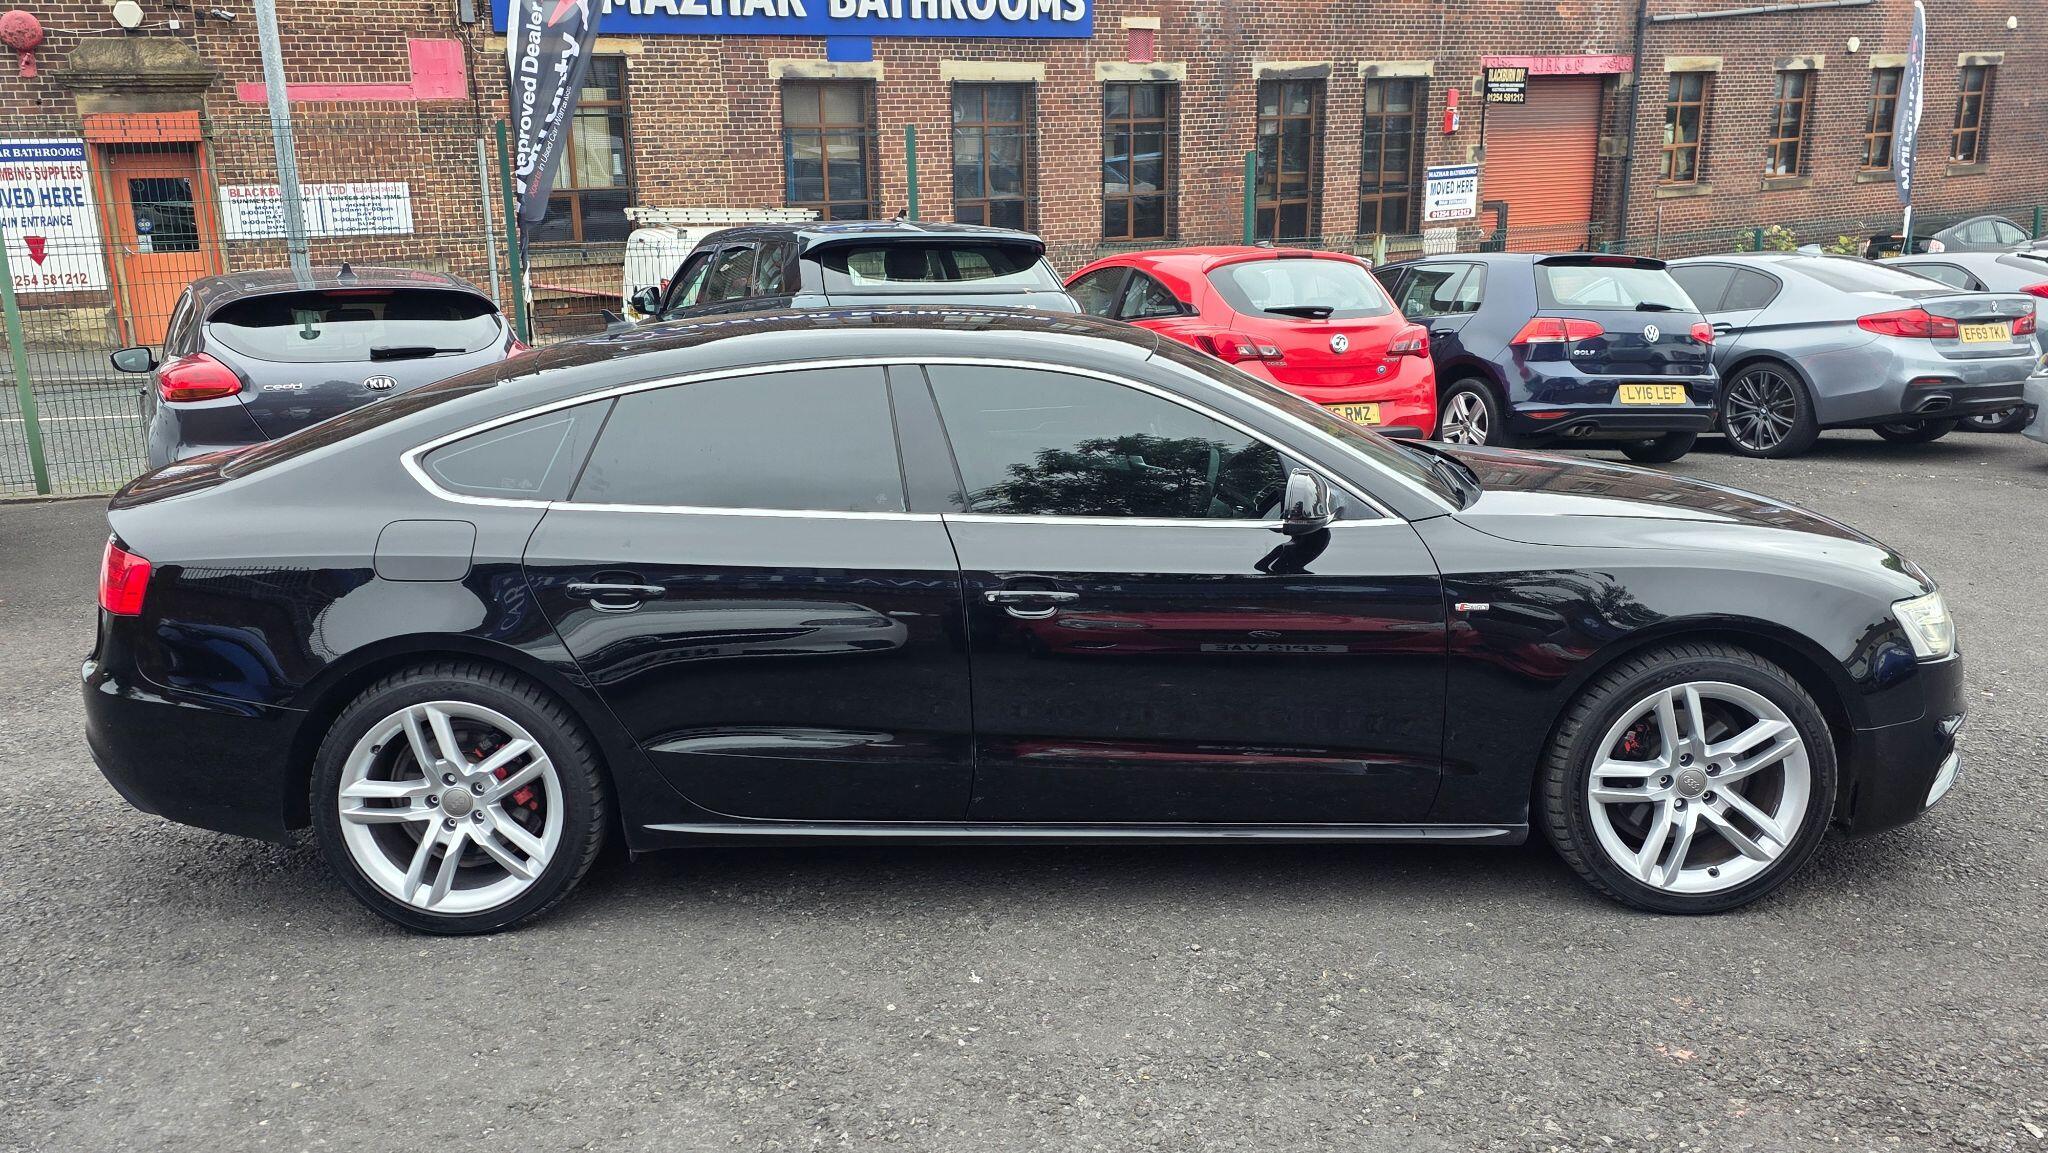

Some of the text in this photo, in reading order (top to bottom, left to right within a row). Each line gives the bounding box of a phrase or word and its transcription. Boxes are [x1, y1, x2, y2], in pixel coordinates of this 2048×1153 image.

[829, 0, 1086, 22] BATHROOMS
[521, 1, 543, 74] Dealer
[13, 147, 82, 158] BATHROOMS
[541, 141, 553, 163] Used
[549, 126, 558, 142] Car
[34, 165, 84, 181] SUPPLIES
[229, 186, 283, 198] BLACKBU
[326, 185, 346, 195] LTD
[1430, 179, 1473, 196] MOVED HERE
[0, 186, 84, 209] VED HERE
[21, 215, 72, 228] ENTRANCE
[13, 272, 88, 287] 254 581212
[1965, 325, 2006, 341] EF69 TKA
[368, 378, 393, 389] KIA
[1627, 386, 1678, 400] LY16 LEF
[1345, 406, 1371, 422] RMZ
